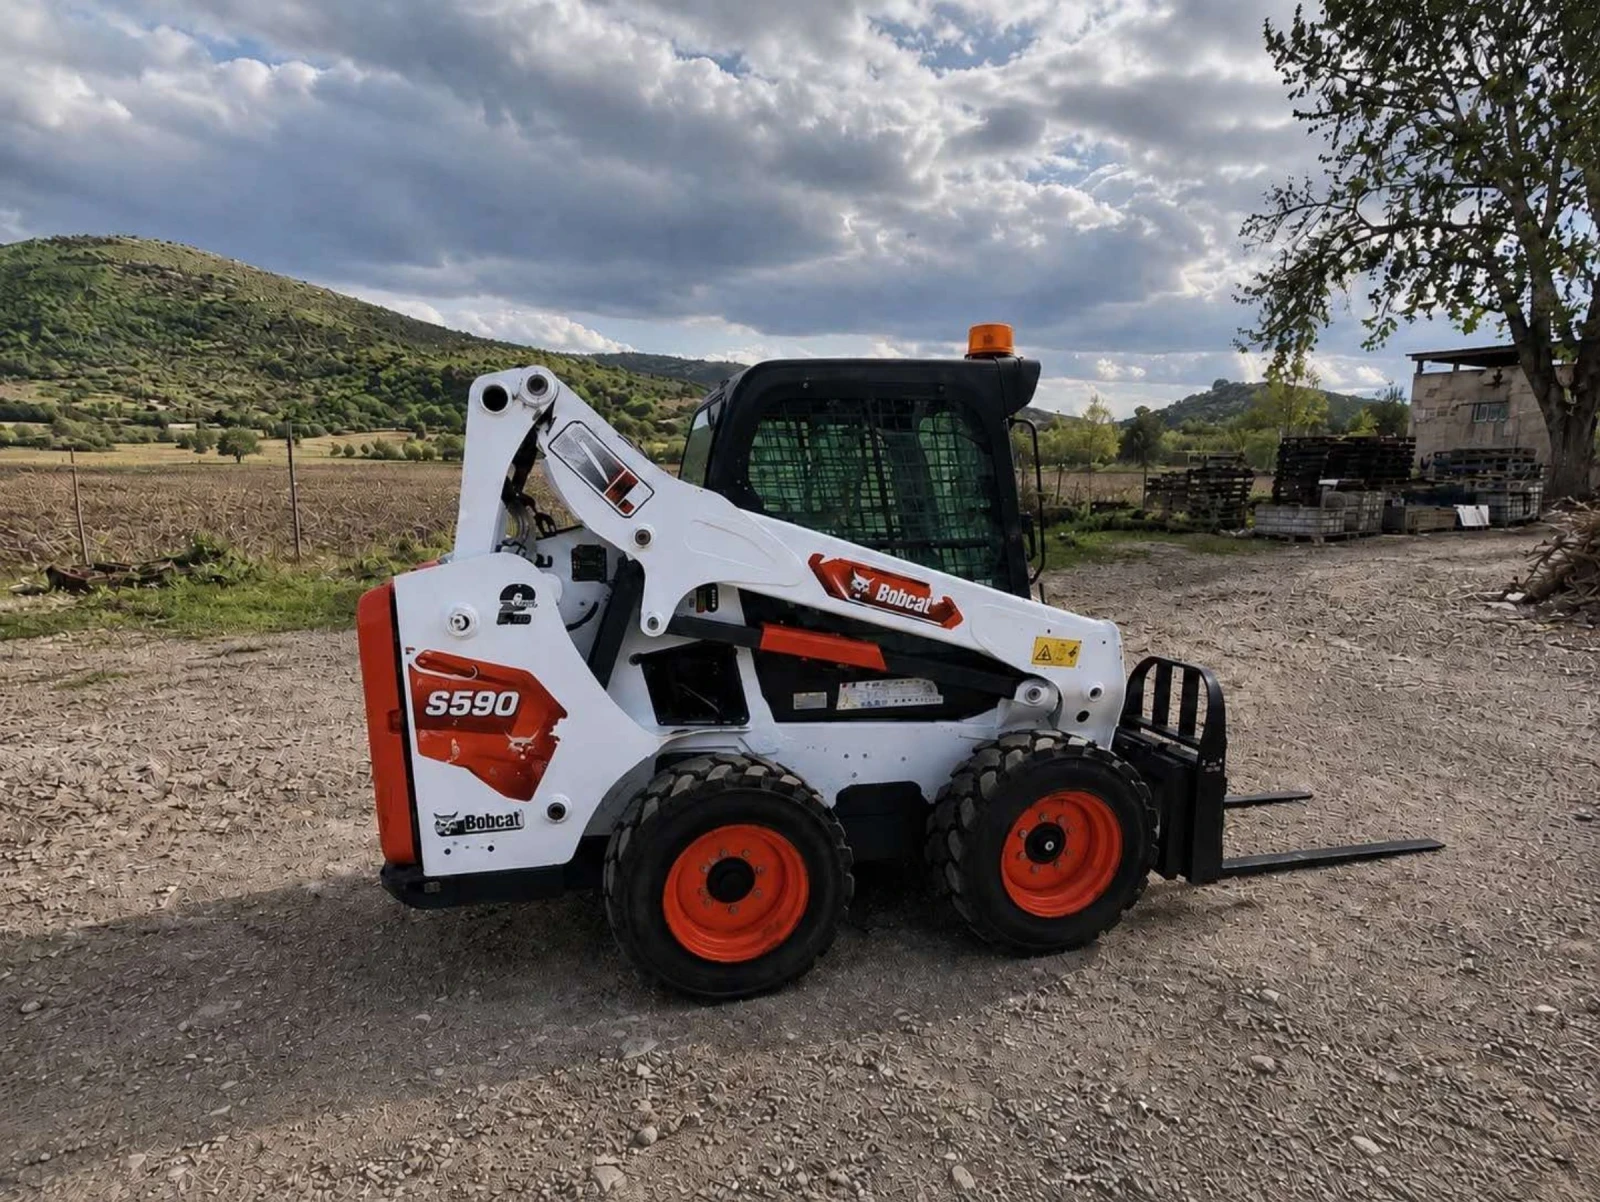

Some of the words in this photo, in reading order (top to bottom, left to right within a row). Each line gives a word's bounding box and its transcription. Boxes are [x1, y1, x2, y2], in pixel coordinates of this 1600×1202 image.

[876, 583, 932, 614] Bobcat
[425, 690, 520, 717] S590
[464, 811, 520, 830] Bobcat
